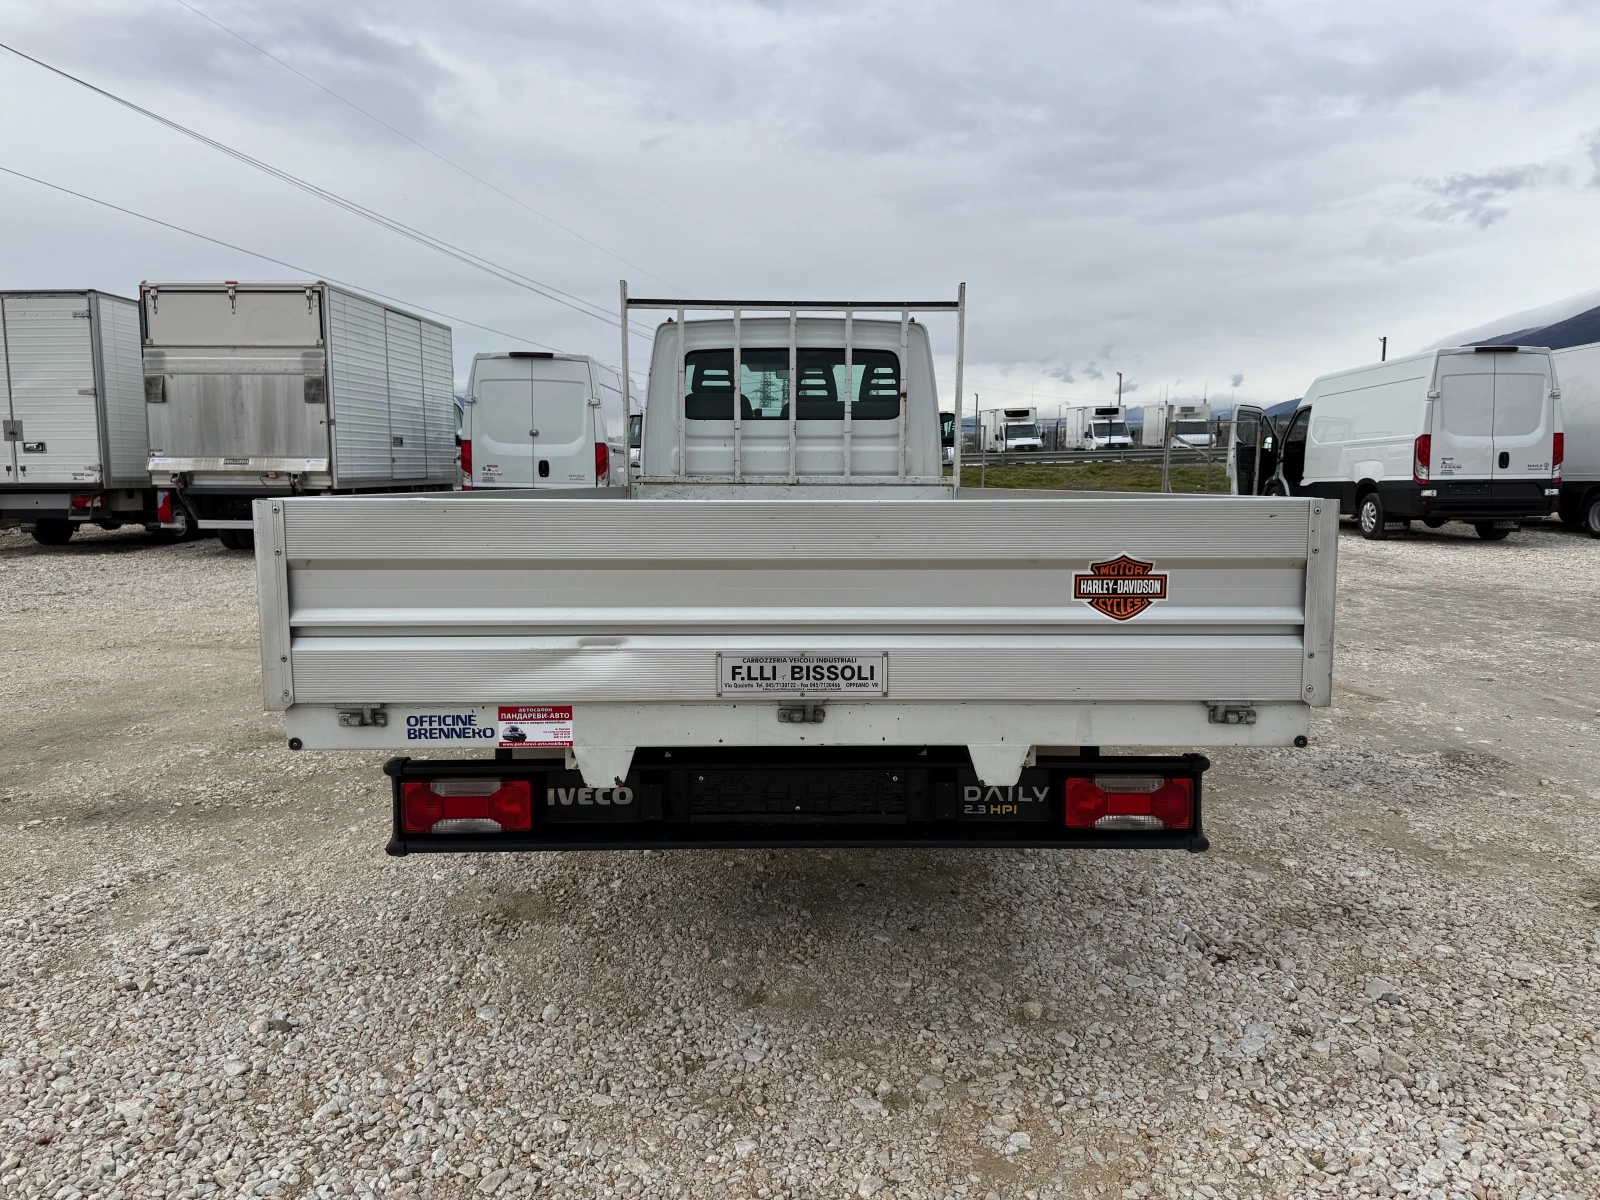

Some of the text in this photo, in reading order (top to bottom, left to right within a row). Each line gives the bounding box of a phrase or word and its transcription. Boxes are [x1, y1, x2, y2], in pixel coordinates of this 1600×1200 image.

[1100, 561, 1143, 575] MOTOR
[1080, 579, 1161, 594] HARLEY-DAVIDSON
[1099, 598, 1142, 616] CYCLES
[731, 665, 875, 681] F.LLI BISSOLI
[406, 714, 477, 727] OFFICINE
[500, 712, 570, 720] ПАНДАРЕВИ-АВТО
[407, 727, 495, 740] BRENNERO
[547, 787, 634, 806] IVECO
[963, 786, 1050, 802] DAILY
[964, 804, 1017, 815] 2.3 HPI
